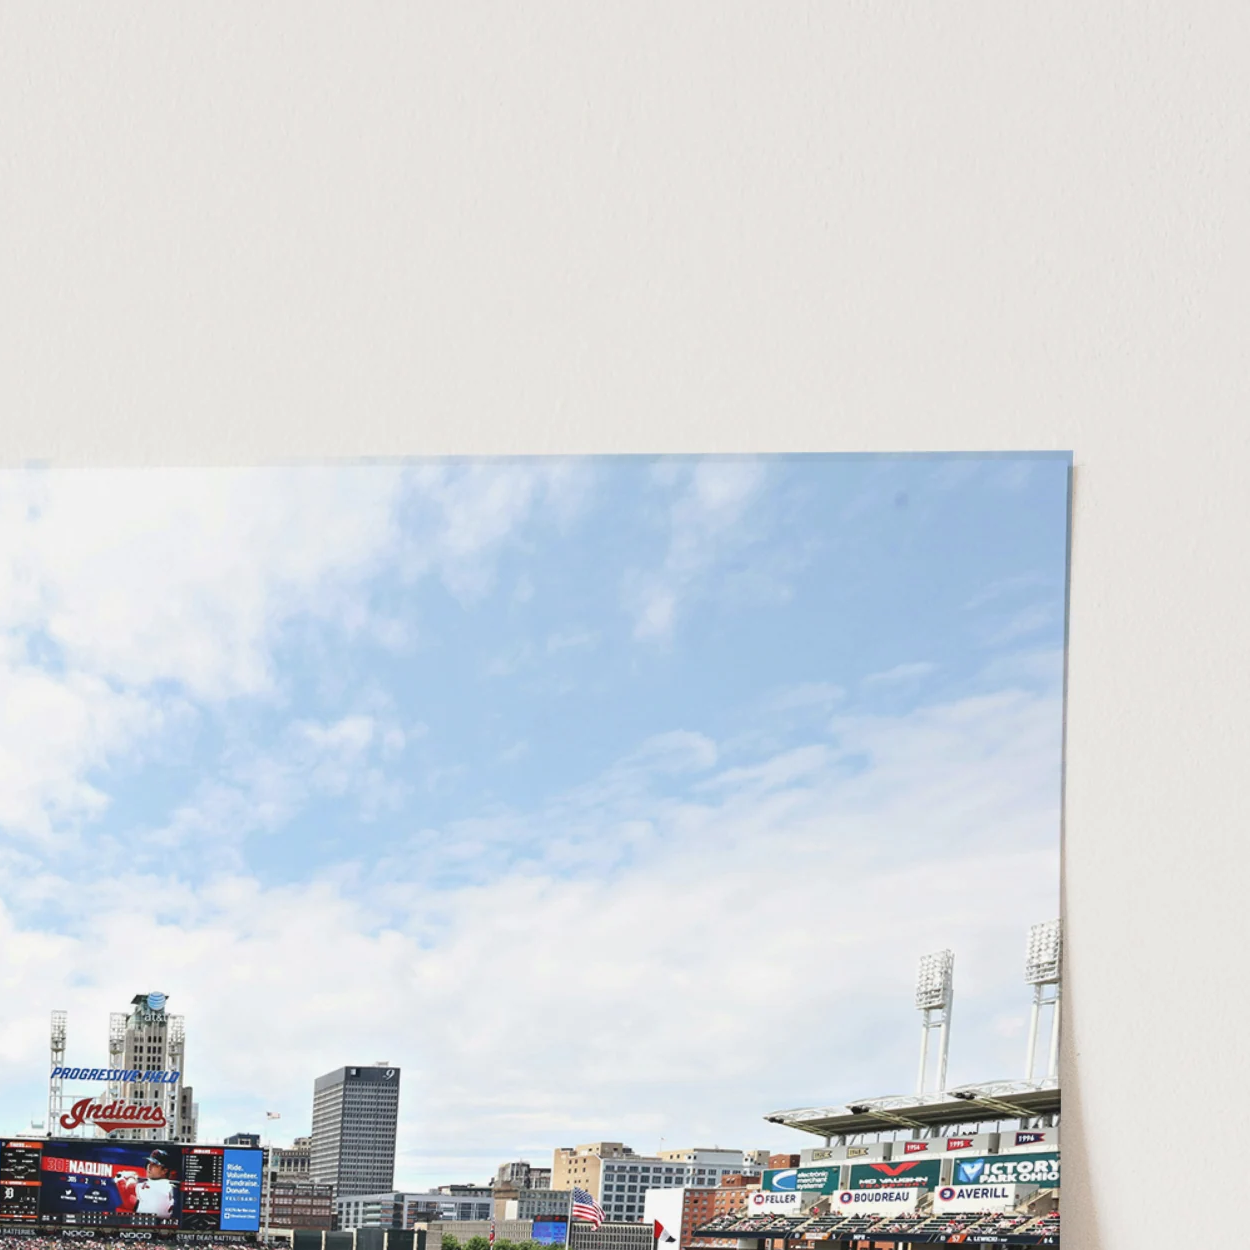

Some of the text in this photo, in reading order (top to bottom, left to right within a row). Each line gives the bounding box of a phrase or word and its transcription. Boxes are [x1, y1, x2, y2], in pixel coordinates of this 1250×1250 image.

[51, 1067, 181, 1083] PROGRESSIVE FIELD
[60, 1098, 166, 1133] Indians
[69, 1160, 113, 1177] NAQUIN
[979, 1171, 1059, 1184] PARK OHIO
[765, 1194, 796, 1204] FELLER
[854, 1192, 910, 1203] BOUDREAU
[957, 1187, 1009, 1199] AVERILL
[62, 1230, 94, 1238] NOCO
[120, 1231, 152, 1239] NOCO
